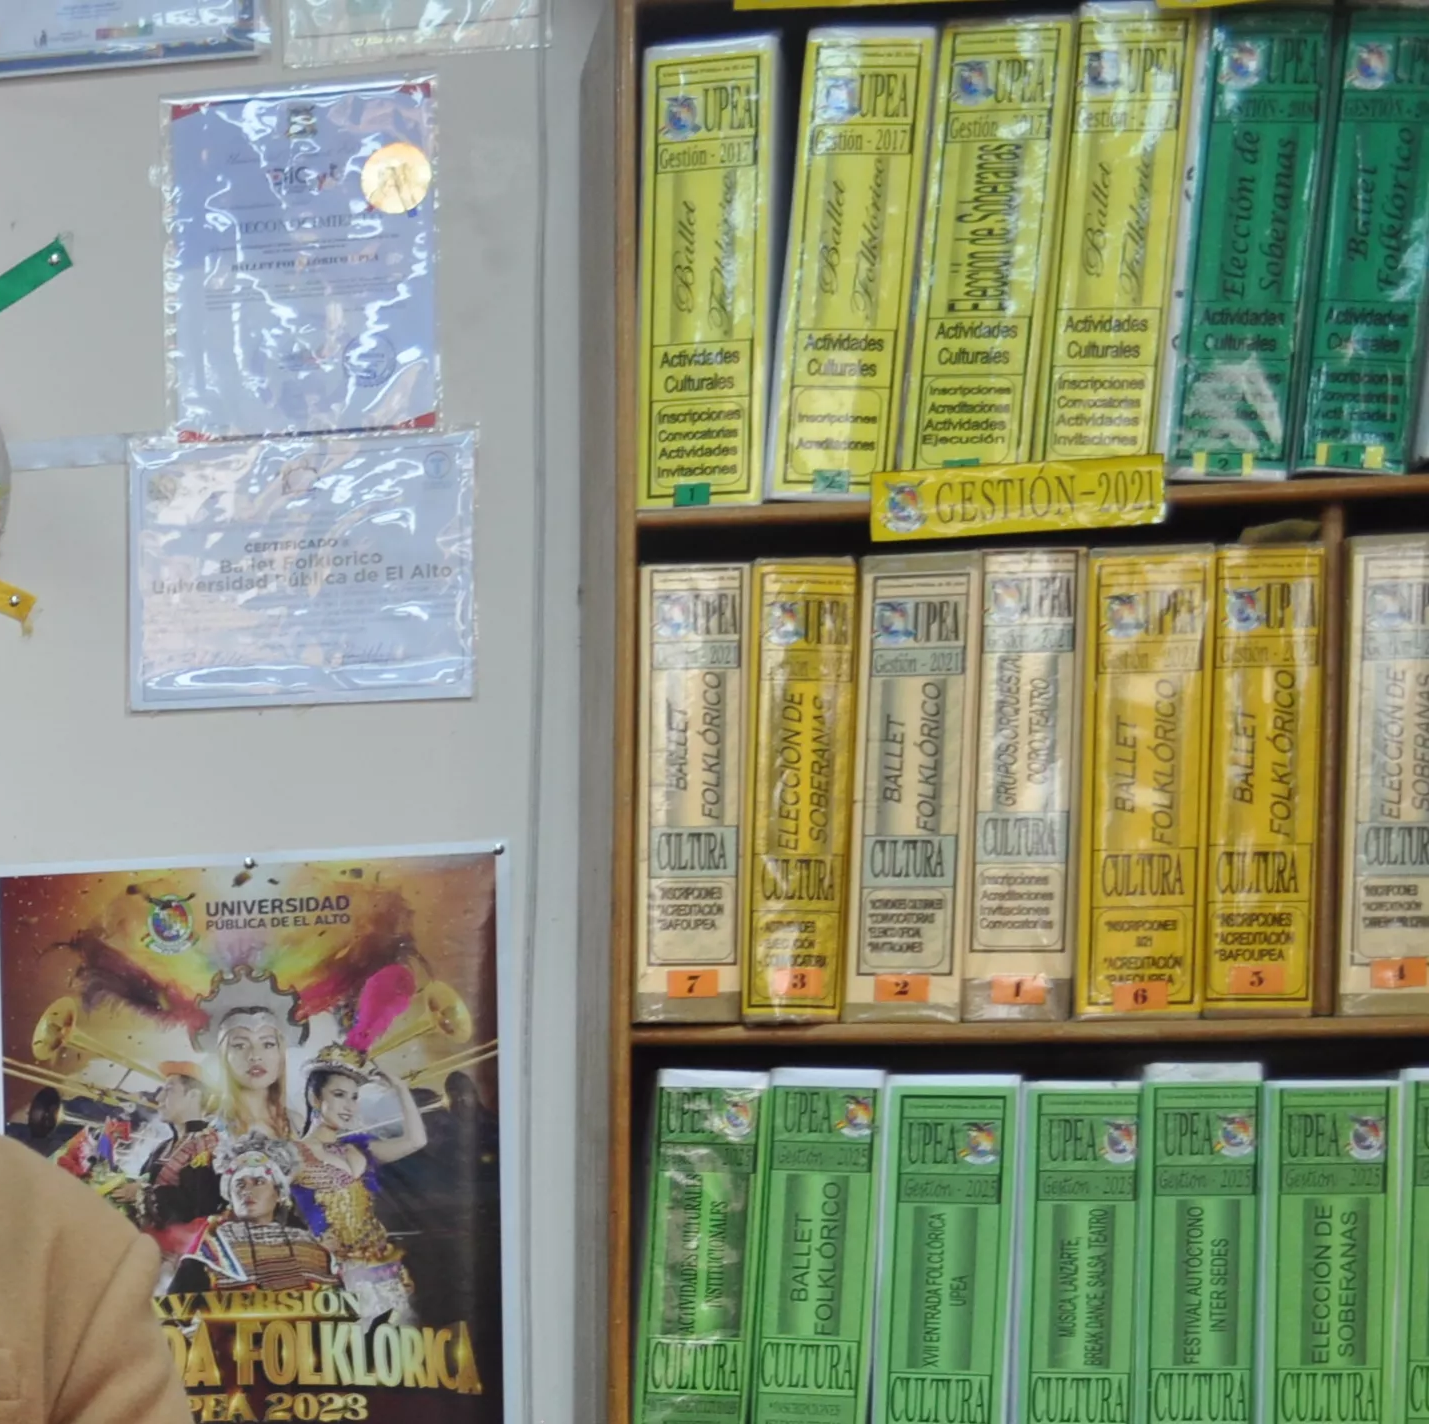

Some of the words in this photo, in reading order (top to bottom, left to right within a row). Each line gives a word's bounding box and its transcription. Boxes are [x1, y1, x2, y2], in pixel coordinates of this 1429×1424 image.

[703, 85, 756, 132] UPEA
[860, 72, 908, 119] UPEA
[660, 145, 706, 169] Gestión
[876, 130, 908, 150] 2017
[804, 334, 884, 353] Actividades
[935, 320, 1018, 339] Actividades
[1064, 315, 1147, 333] Actividades
[660, 347, 739, 369] Actividades
[807, 358, 877, 377] Culturales
[937, 346, 1009, 364] Culturales
[1067, 340, 1140, 360] Culturales
[665, 373, 734, 394] Culturales
[276, 570, 347, 588] úblca
[354, 568, 378, 583] de
[386, 565, 403, 581] El
[410, 563, 452, 579] Alto
[914, 601, 959, 643] UPEA
[782, 693, 803, 724] DE
[698, 671, 721, 820] FOLKLÓRICO
[883, 714, 905, 804] BALLET
[913, 682, 941, 832] FOLKLÓRICO
[1115, 715, 1137, 813] BALLET
[1147, 679, 1177, 845] FOLKLÓRICO
[1233, 706, 1256, 805] BALLET
[1266, 669, 1295, 837] FOLKLÓRICO
[657, 833, 727, 871] CULTURA
[983, 817, 1057, 856] CULTURA
[1363, 826, 1429, 866] CULTUR
[870, 839, 944, 878] CULTURA
[1102, 853, 1185, 897] CULTURA
[1216, 851, 1299, 894] CULTURA
[761, 859, 835, 901] CULTURA
[206, 895, 350, 917] UNIVERSIDAD
[206, 917, 267, 930] PÚBLICA
[271, 917, 289, 928] DE
[293, 916, 309, 926] EL
[314, 914, 350, 925] ALTO
[687, 975, 701, 993] 7
[792, 973, 807, 989] 3
[894, 980, 909, 995] 2
[1133, 988, 1148, 1005] 6
[1250, 971, 1264, 988] 5
[783, 1091, 833, 1133] UPEA
[907, 1122, 958, 1165] UPEA
[1047, 1118, 1098, 1162] UPEA
[1163, 1112, 1214, 1156] UPEA
[1287, 1113, 1340, 1158] UPEA
[1314, 1205, 1333, 1237] DE
[791, 1212, 813, 1301] BALLET
[813, 1182, 841, 1335] FOLKLÓRICO
[924, 1213, 947, 1285] FOLCLÓRICA
[1183, 1206, 1205, 1296] AUTÓCTONO
[1210, 1237, 1229, 1286] SEDES
[205, 1285, 361, 1318] VERSIÓN
[949, 1275, 969, 1307] UPEA
[1305, 1243, 1332, 1364] ELECCIÓN
[1338, 1211, 1359, 1358] SOBERANAS
[923, 1288, 942, 1343] ENTRADA
[1183, 1300, 1203, 1364] FESTIVAL
[1210, 1290, 1227, 1332] INTER
[235, 1308, 482, 1394] FOLKLÓRICA
[651, 1341, 739, 1391] CULTURA
[760, 1341, 854, 1390] CULTURA
[922, 1346, 939, 1367] XVII
[891, 1376, 986, 1424] CULTURA
[1032, 1376, 1127, 1424] CULTURA
[1154, 1372, 1248, 1423] CULTURA
[1281, 1371, 1377, 1423] CULTURA
